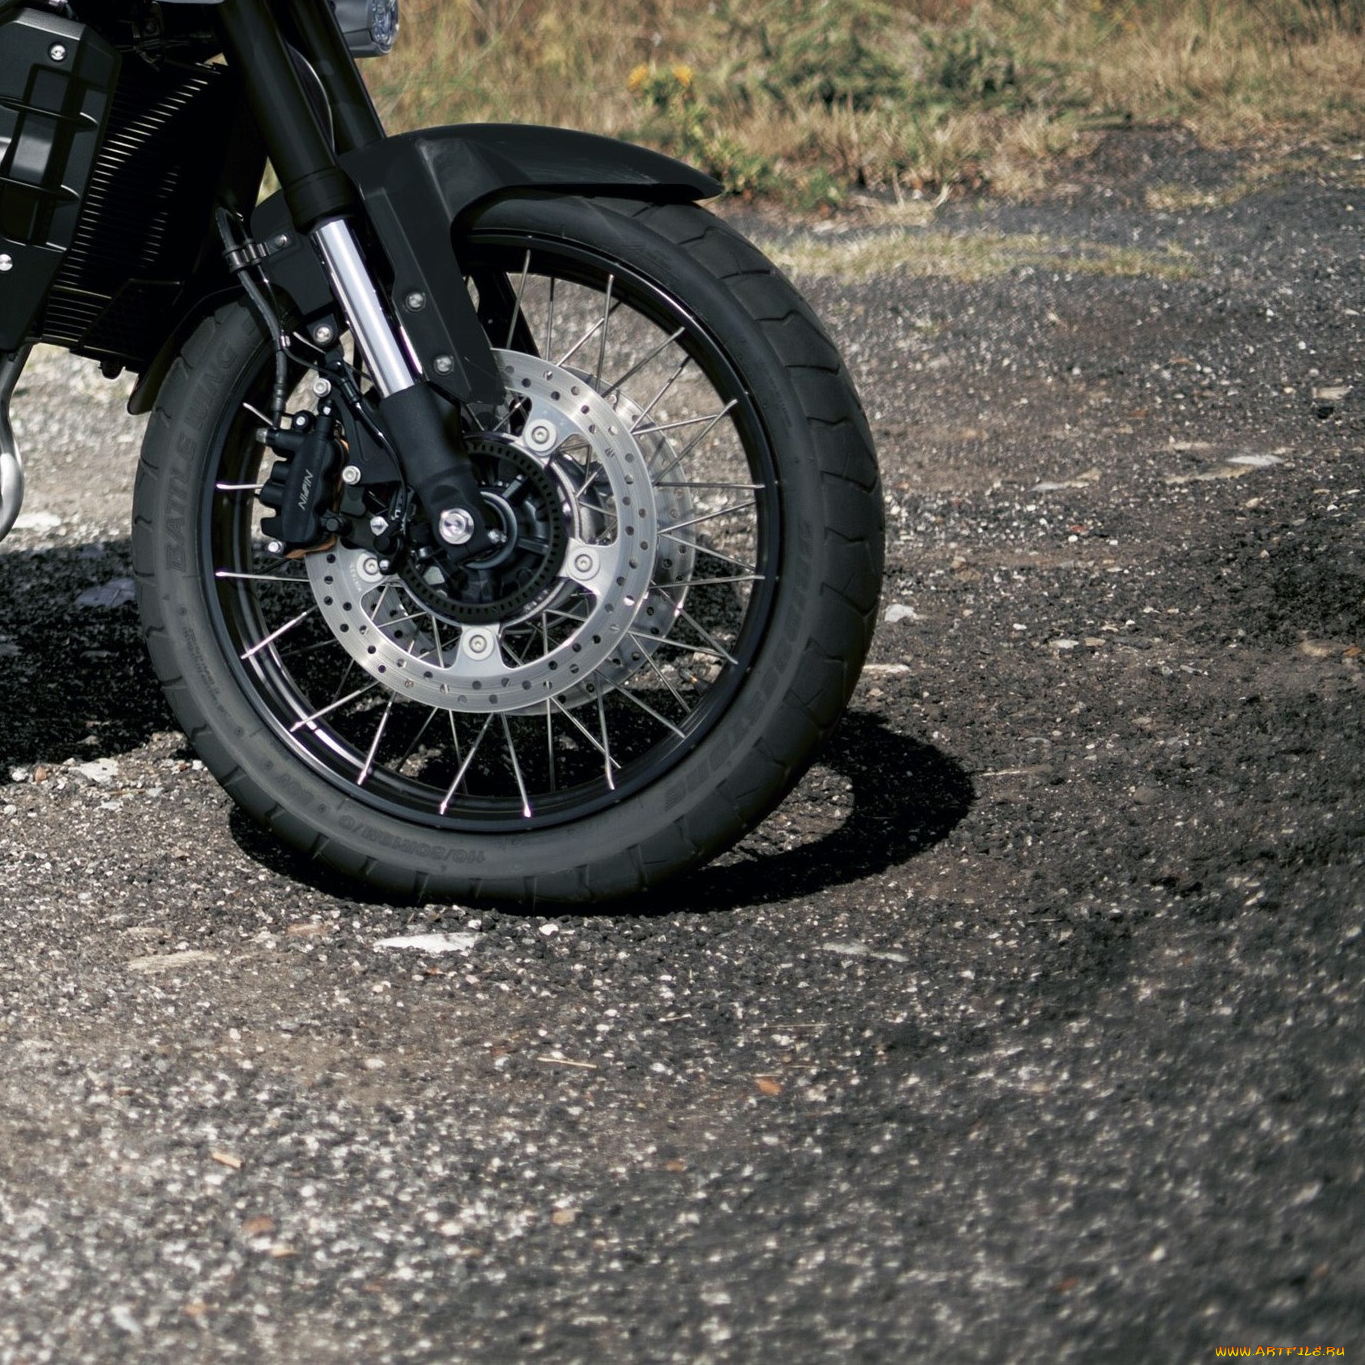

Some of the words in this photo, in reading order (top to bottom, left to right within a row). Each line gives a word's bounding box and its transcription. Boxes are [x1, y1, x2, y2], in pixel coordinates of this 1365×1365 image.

[166, 434, 197, 572] BATTLE
[185, 346, 238, 432] WING
[298, 469, 314, 511] NISSIN
